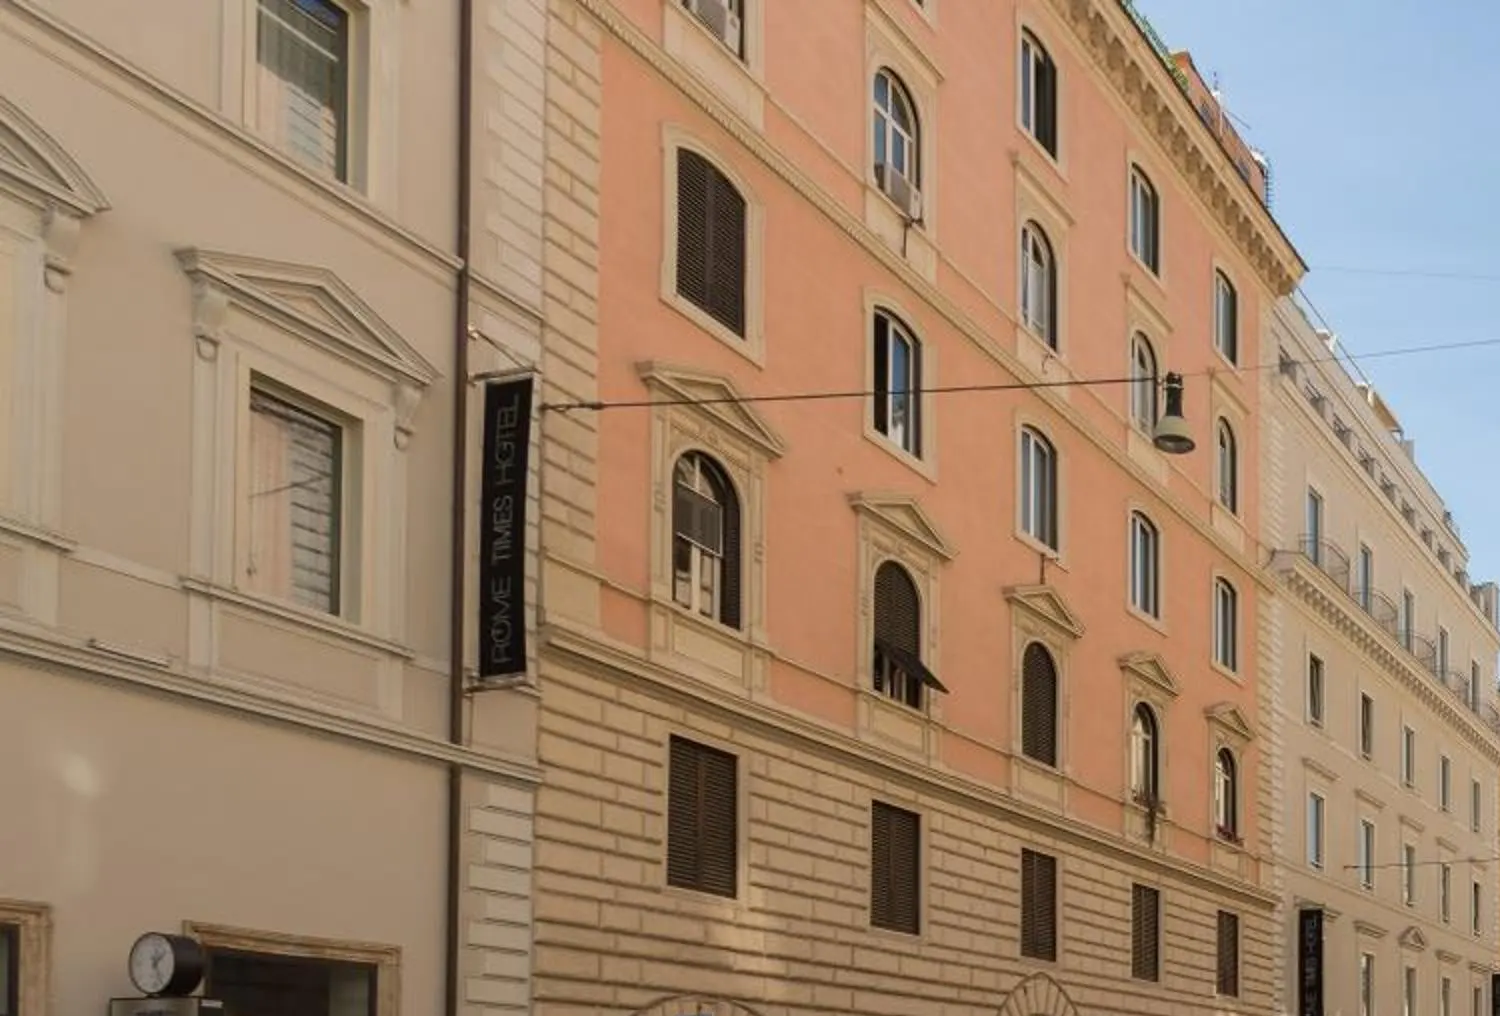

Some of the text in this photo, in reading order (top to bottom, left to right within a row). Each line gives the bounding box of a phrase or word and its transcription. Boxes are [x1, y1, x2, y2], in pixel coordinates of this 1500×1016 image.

[492, 393, 520, 664] ROME TIMES HOTEL
